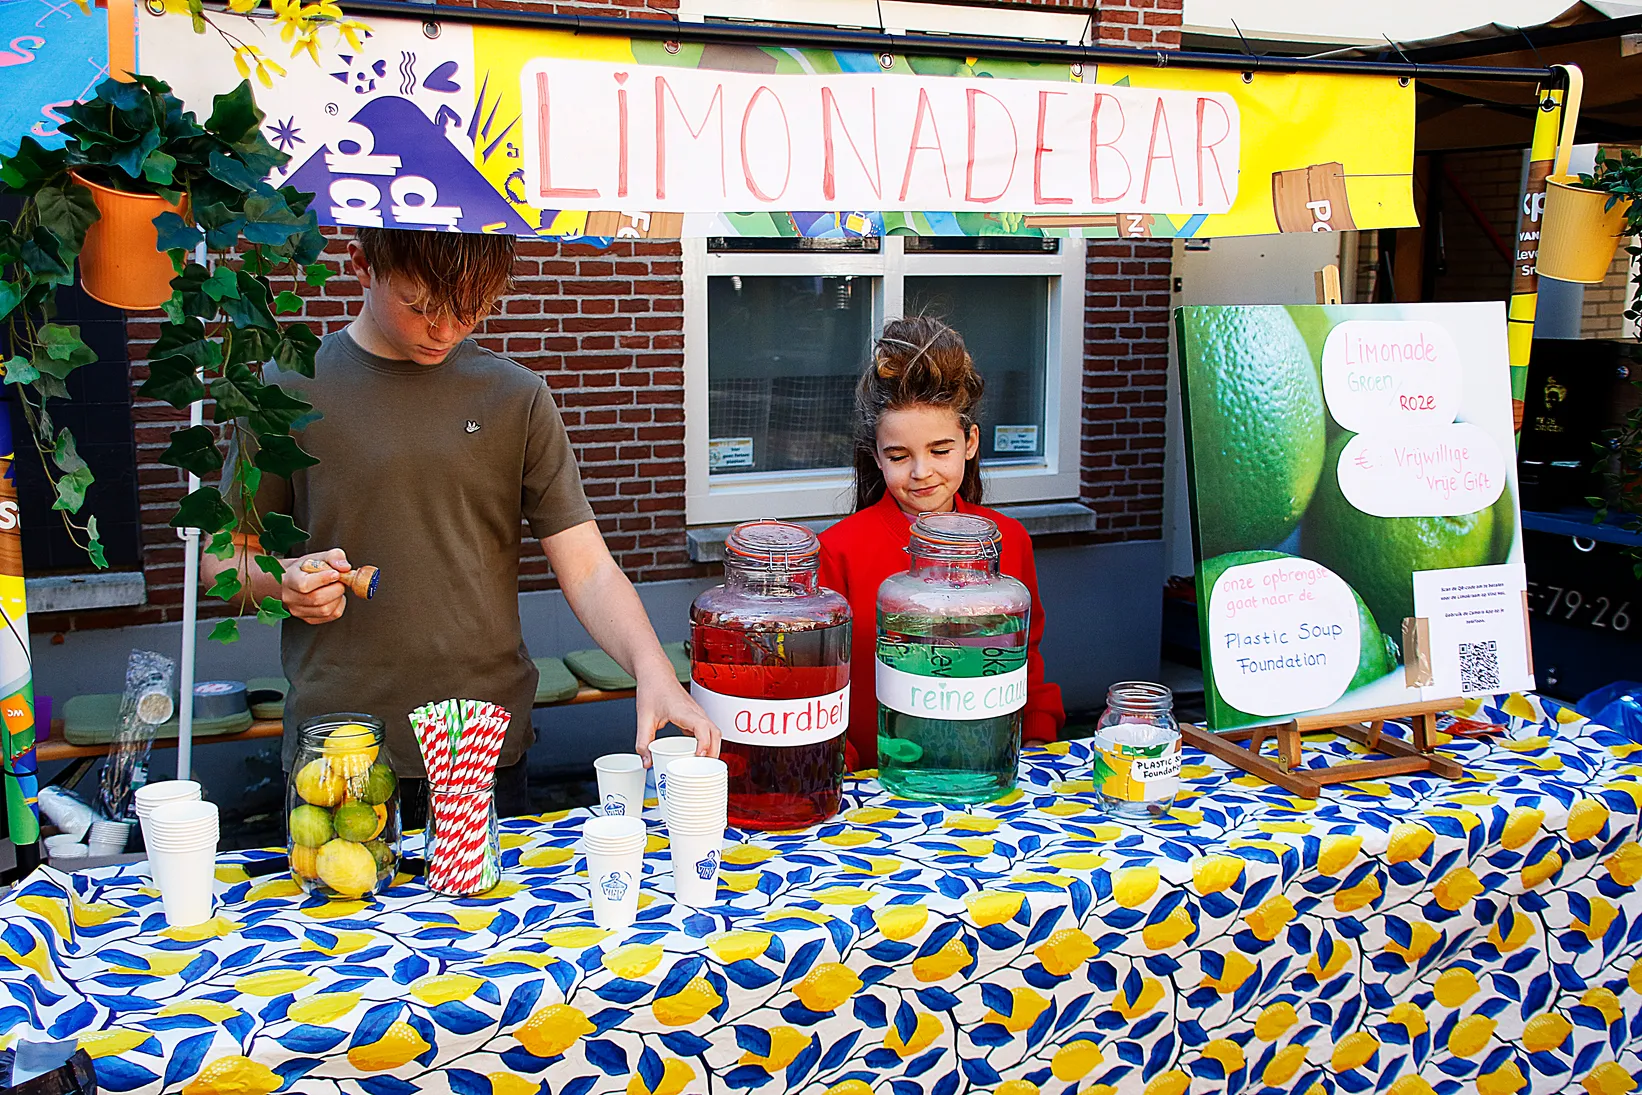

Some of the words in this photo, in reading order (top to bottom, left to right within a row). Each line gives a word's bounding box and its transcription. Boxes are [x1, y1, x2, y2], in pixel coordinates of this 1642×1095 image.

[1463, 471, 1491, 493] Gift
[1223, 577, 1255, 592] onze
[1263, 567, 1328, 592] opbrengst
[1226, 596, 1258, 618] gaat
[1262, 593, 1294, 606] naar
[1298, 588, 1315, 602] de
[1224, 630, 1289, 649] Plastic
[1298, 623, 1343, 641] Soup
[1236, 652, 1327, 675] Foundation
[911, 682, 976, 712] reine
[734, 693, 844, 735] aardbei
[1136, 758, 1172, 770] PLASTIC
